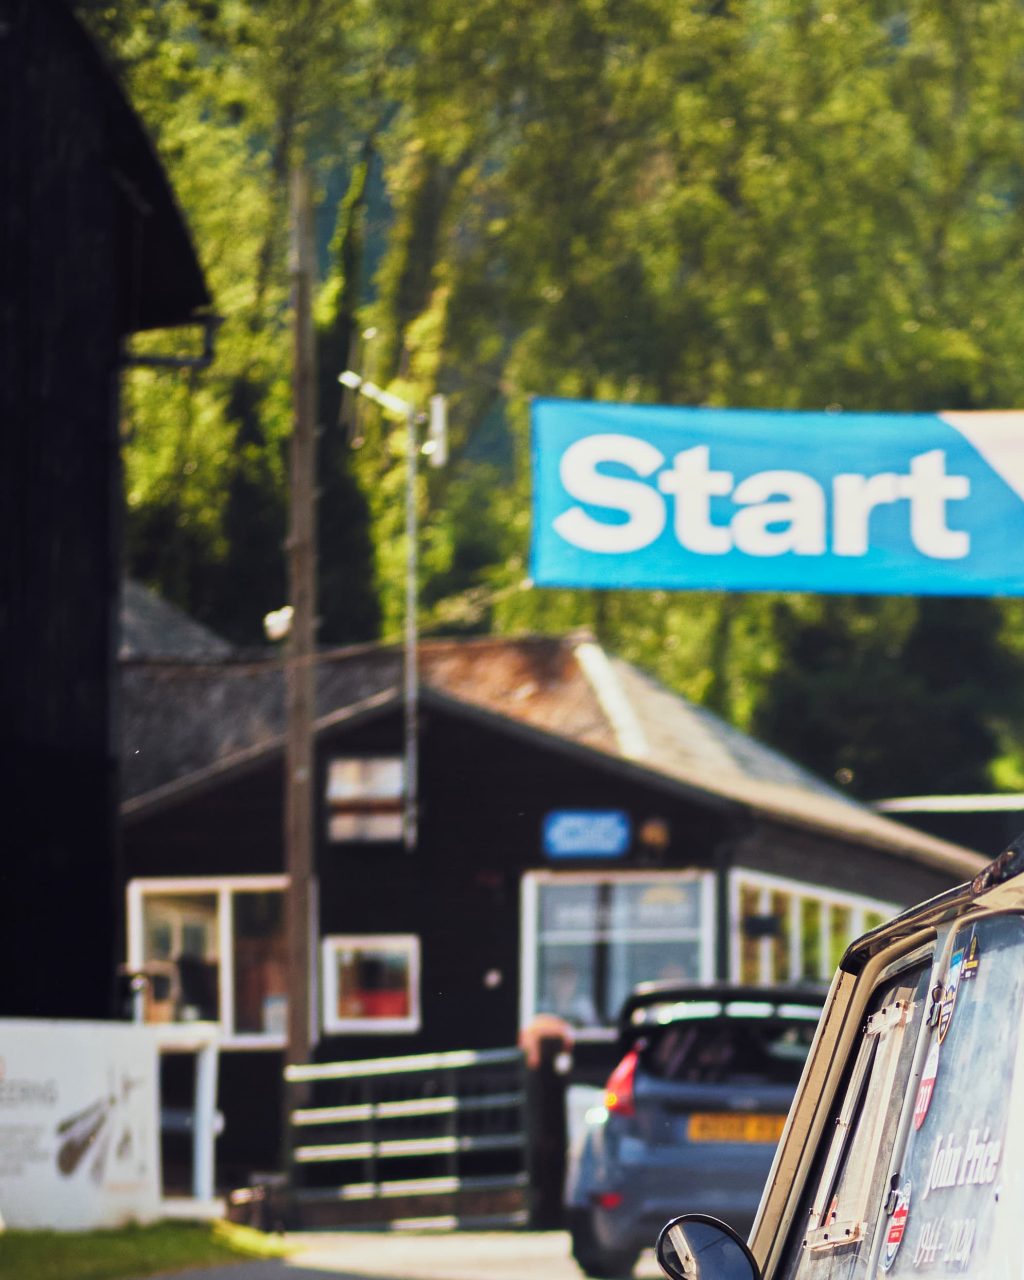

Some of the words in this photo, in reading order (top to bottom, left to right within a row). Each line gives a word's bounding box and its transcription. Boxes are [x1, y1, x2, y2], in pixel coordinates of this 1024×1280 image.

[552, 433, 970, 560] Start
[923, 1134, 962, 1199] John
[957, 1127, 1001, 1184] Price
